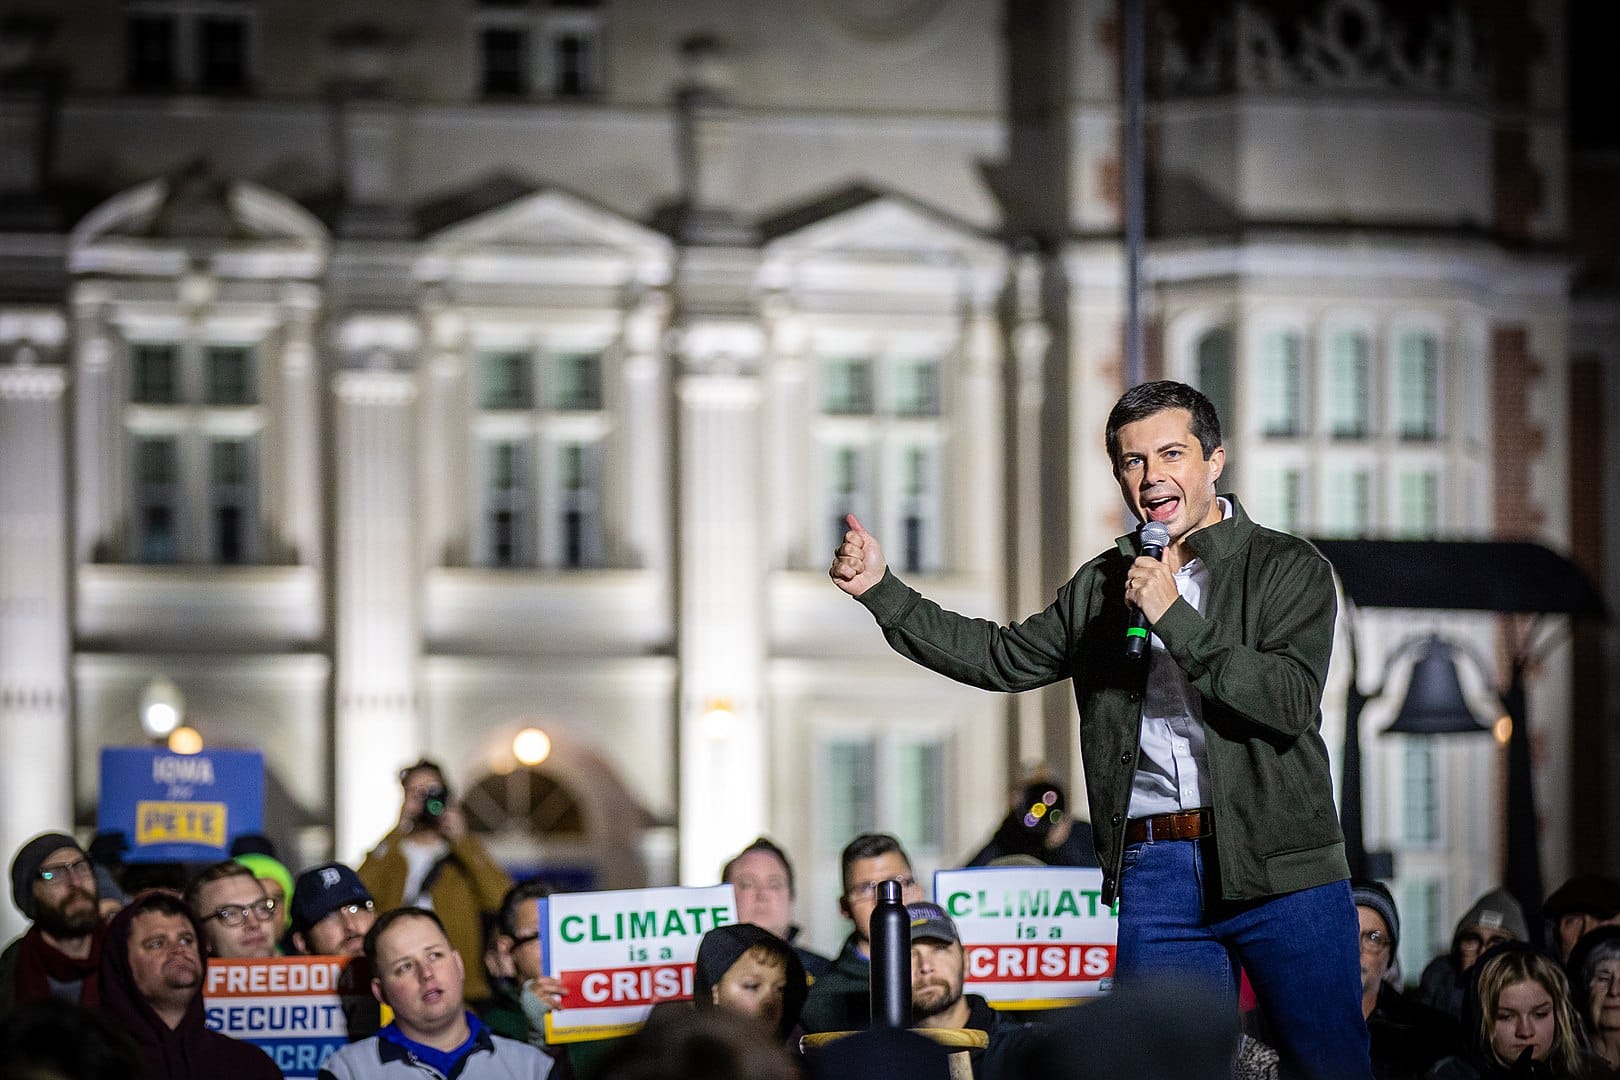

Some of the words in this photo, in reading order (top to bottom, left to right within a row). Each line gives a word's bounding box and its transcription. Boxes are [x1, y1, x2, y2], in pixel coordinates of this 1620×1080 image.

[153, 756, 214, 785] IOWA
[143, 810, 213, 835] PETE
[947, 889, 1119, 917] CLIMAT
[560, 907, 729, 943] CLIMATE
[1016, 922, 1038, 939] is
[1049, 926, 1062, 939] a
[629, 945, 648, 962] is
[660, 946, 672, 960] a
[970, 947, 1109, 977] CRISIS
[581, 966, 694, 1003] CRISI
[206, 1005, 339, 1031] SECURIT
